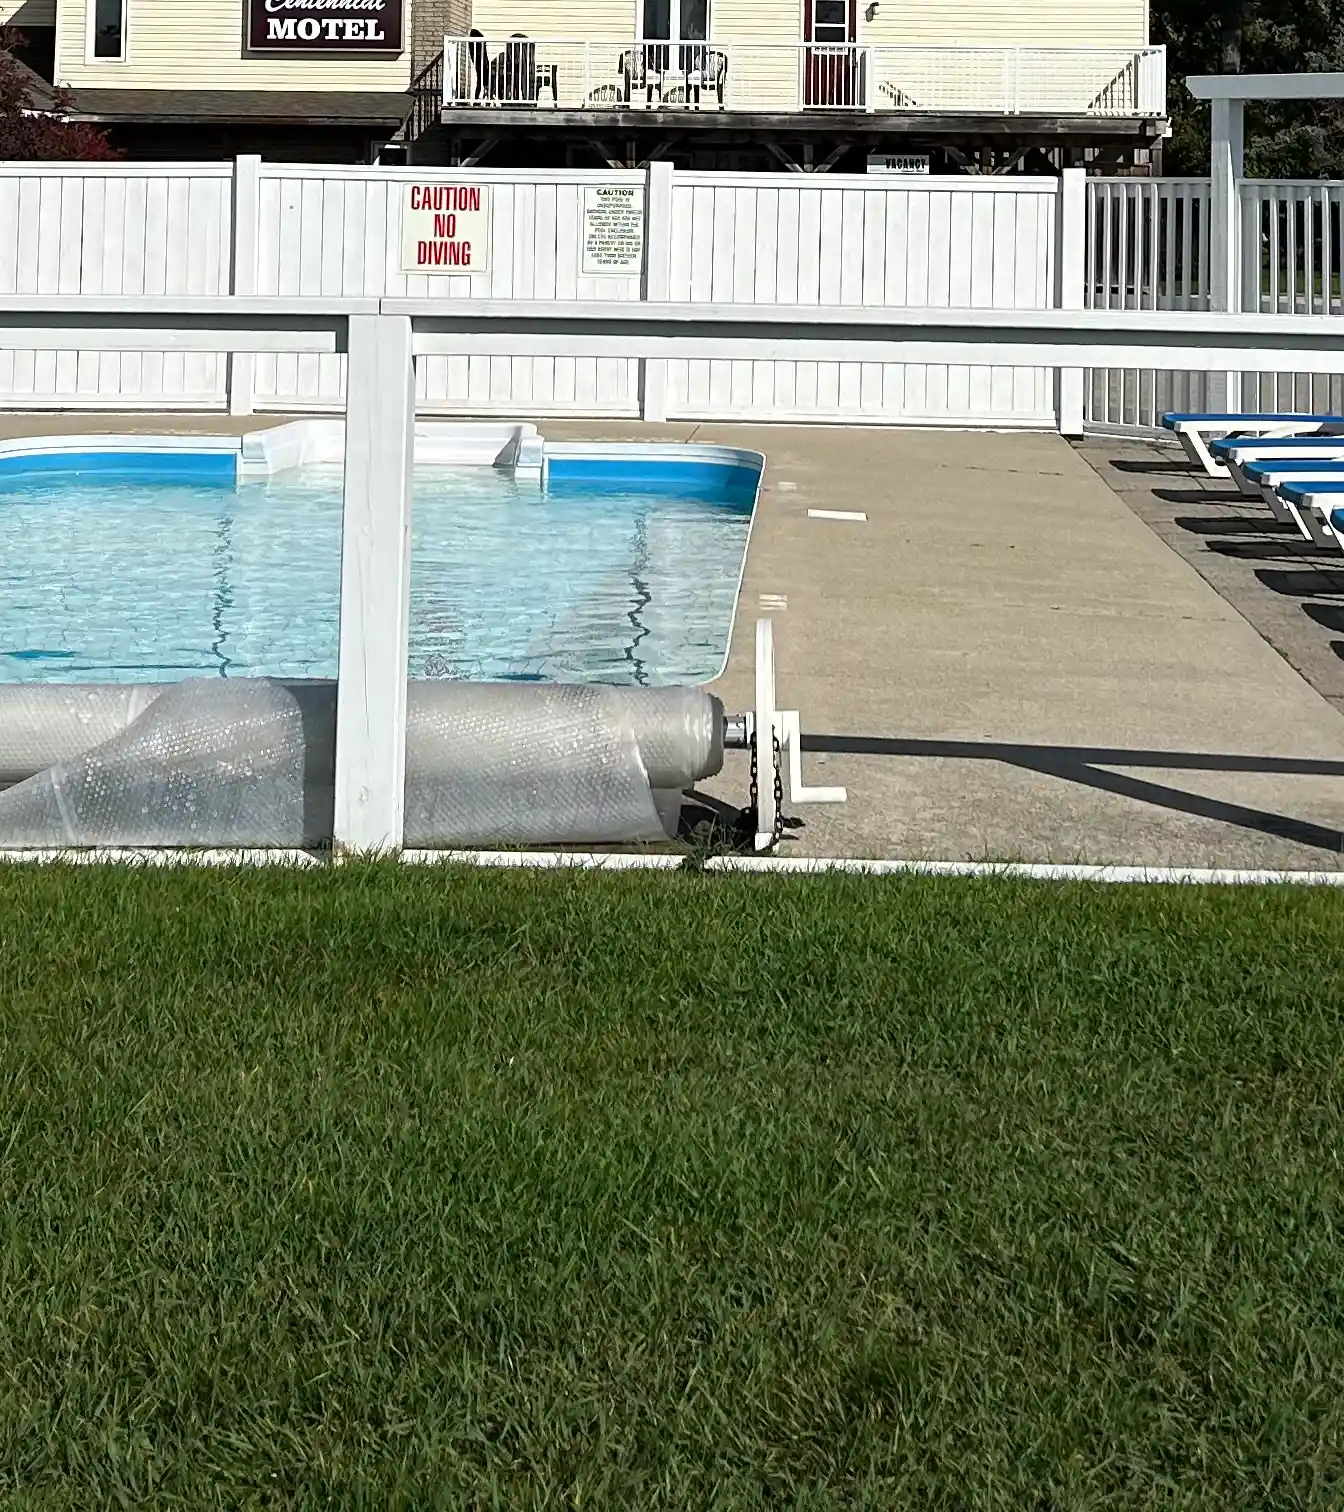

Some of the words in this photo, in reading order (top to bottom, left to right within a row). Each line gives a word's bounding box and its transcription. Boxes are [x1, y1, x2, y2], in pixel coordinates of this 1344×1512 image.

[266, 18, 385, 40] MOTEL
[885, 158, 926, 169] VACANCY
[411, 185, 480, 211] CAUTION
[434, 213, 456, 238] NO
[417, 241, 471, 266] DIVING
